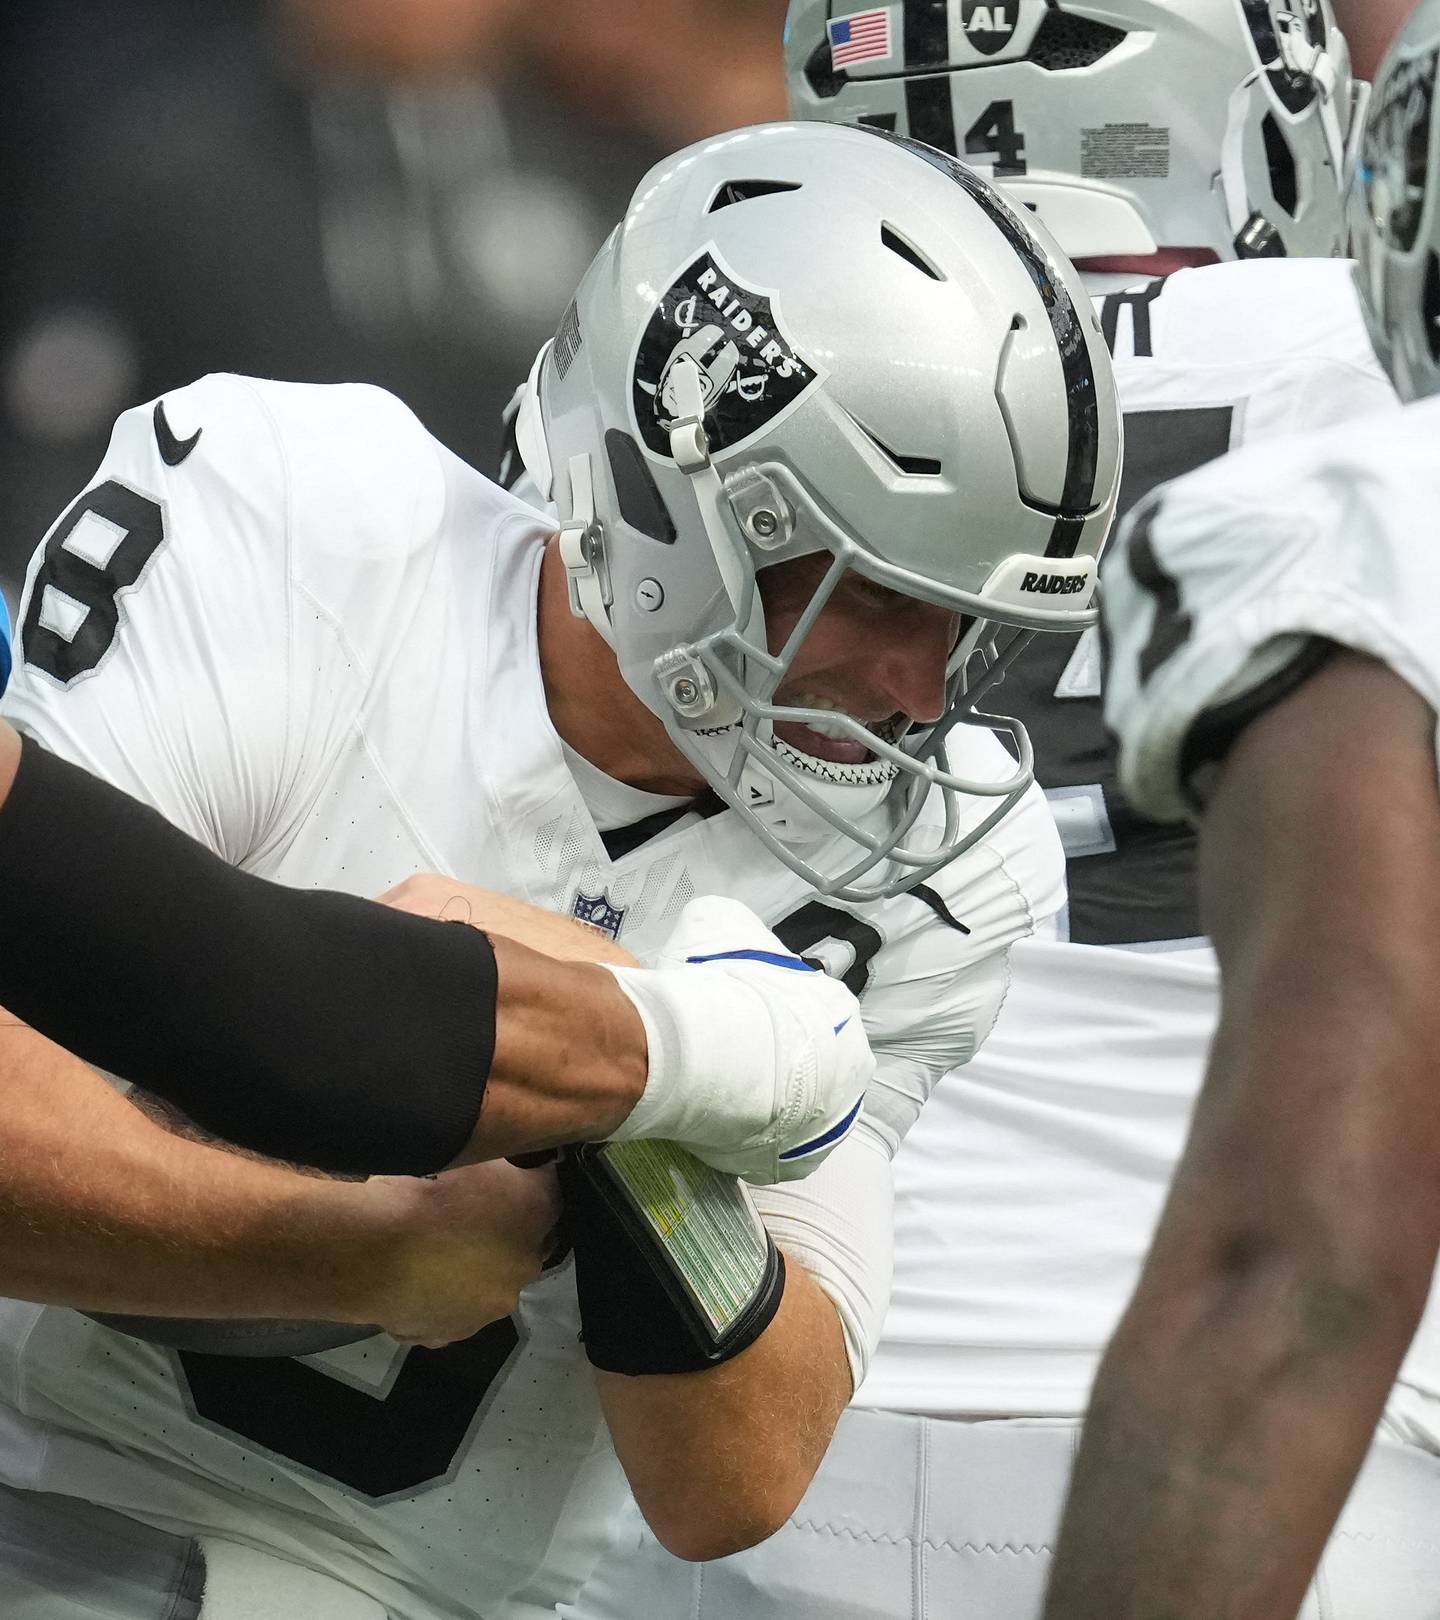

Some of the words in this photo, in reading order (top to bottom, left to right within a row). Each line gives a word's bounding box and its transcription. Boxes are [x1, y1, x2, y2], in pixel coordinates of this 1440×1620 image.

[967, 6, 1013, 31] AL
[696, 266, 803, 378] RAIDERS
[17, 476, 171, 690] 8
[1020, 571, 1089, 594] RAIDERS
